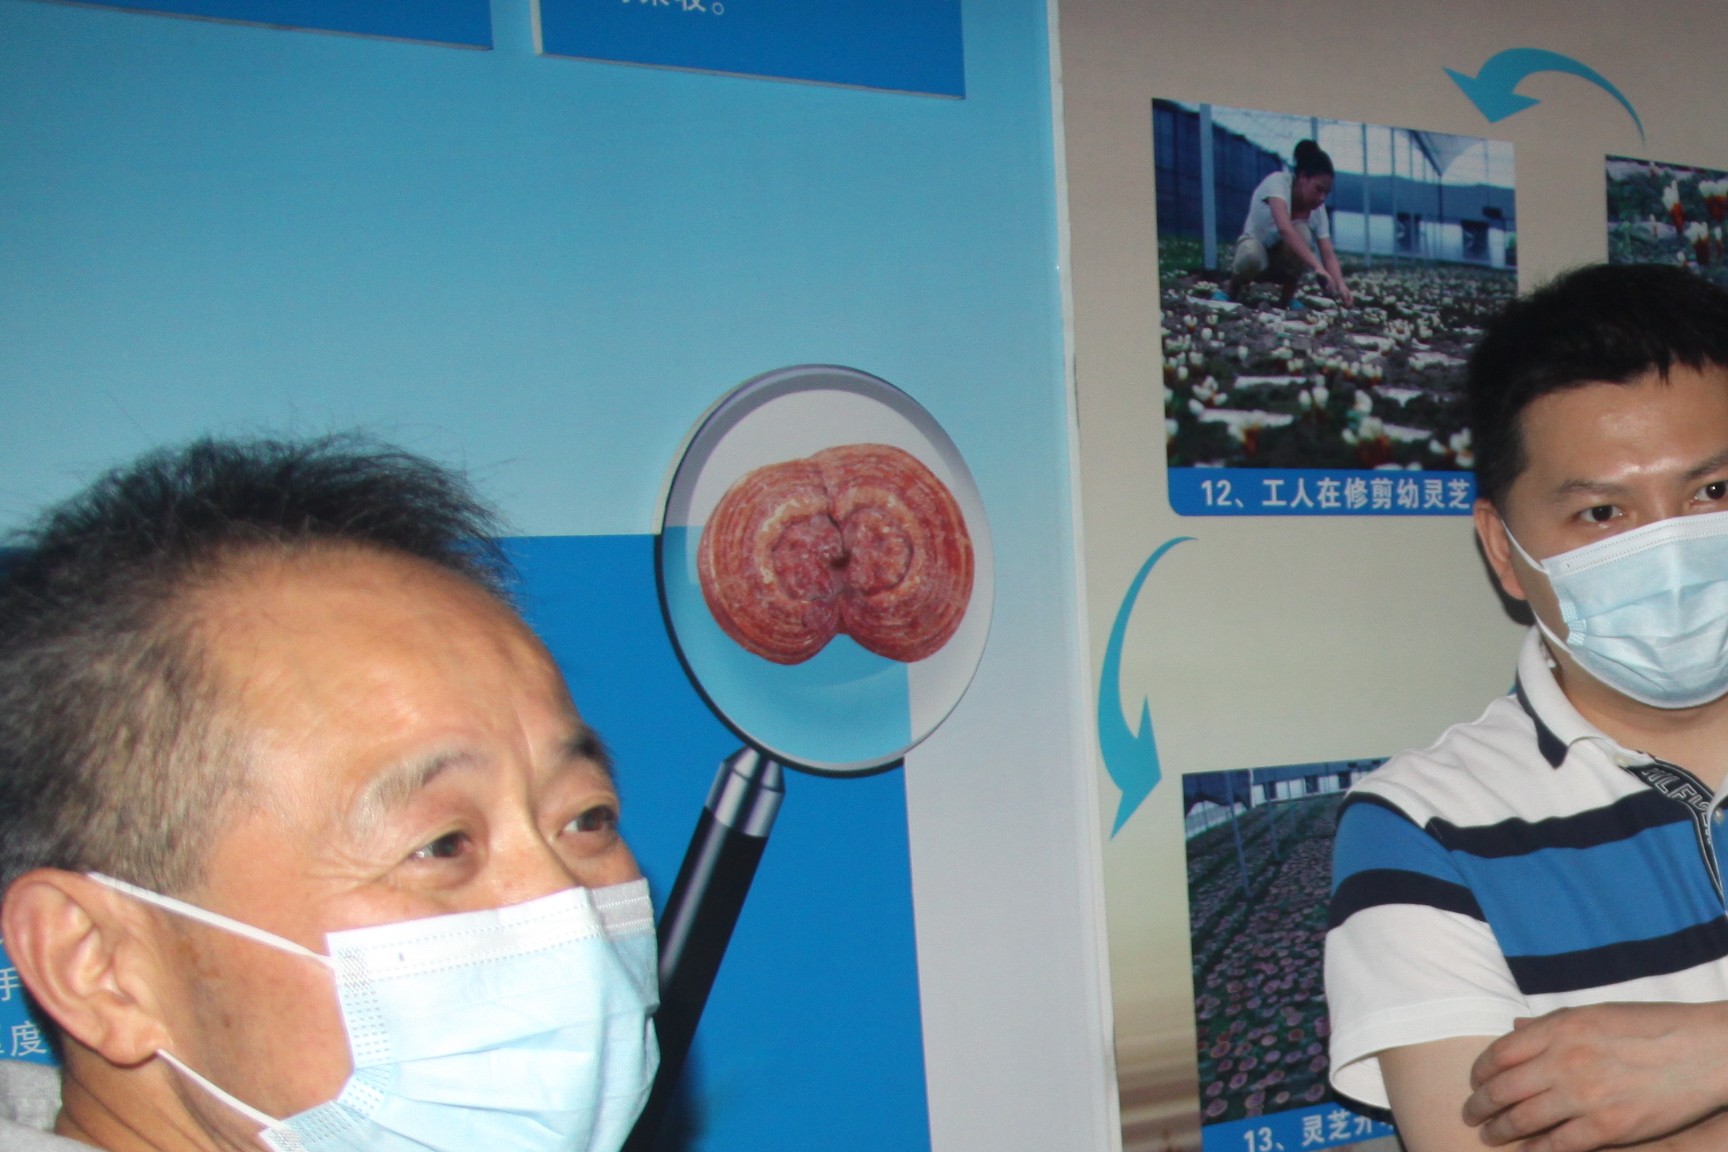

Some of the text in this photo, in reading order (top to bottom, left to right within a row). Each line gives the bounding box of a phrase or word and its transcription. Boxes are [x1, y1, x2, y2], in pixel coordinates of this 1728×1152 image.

[1200, 477, 1471, 509] 12、工人在修剪幼灵芝
